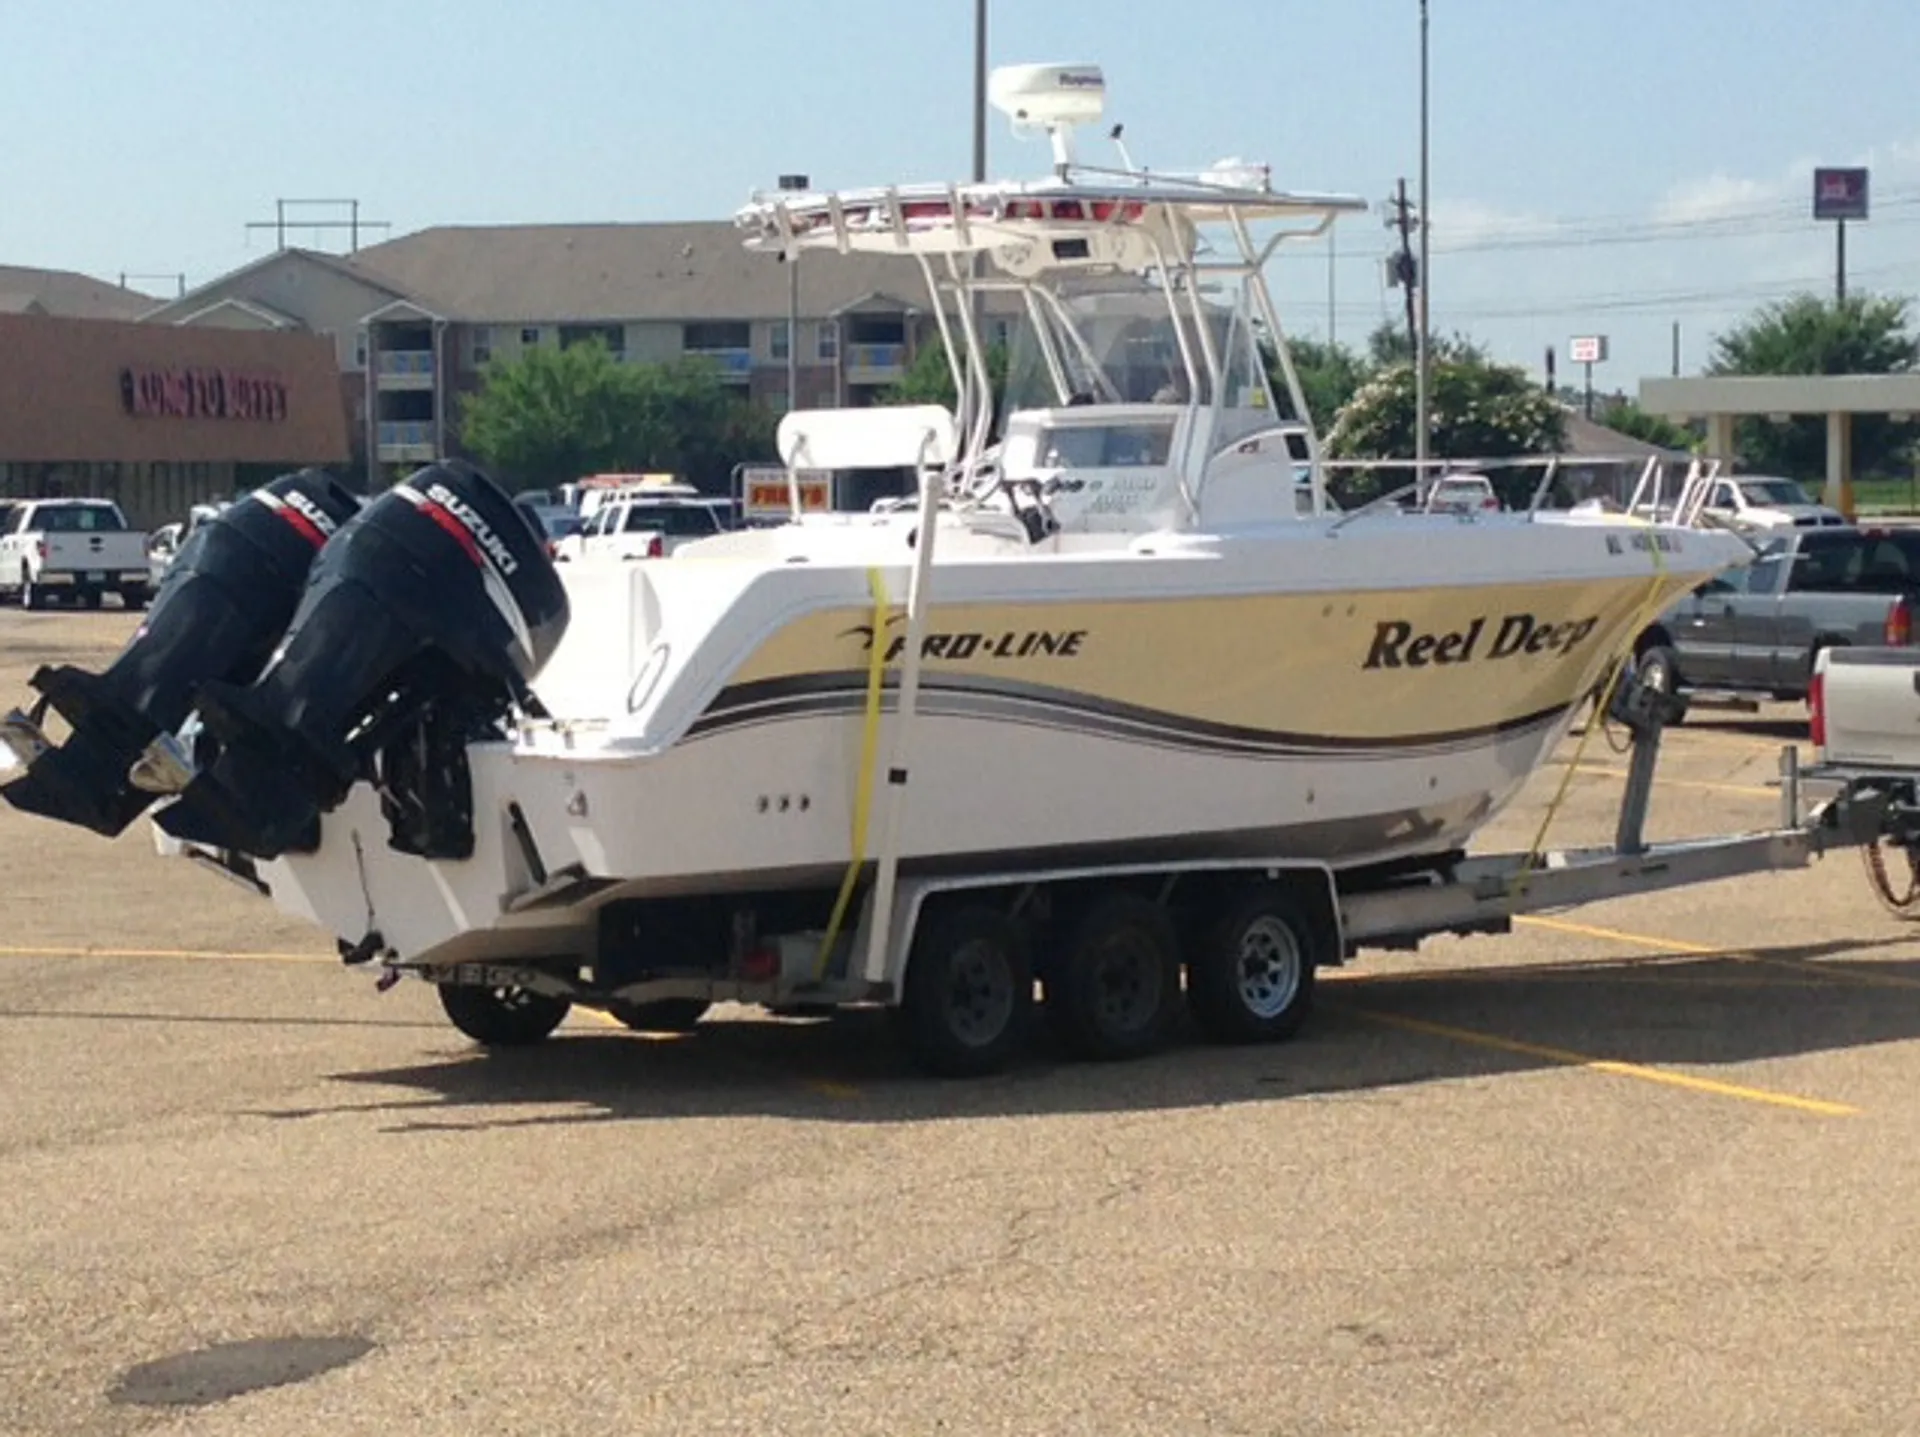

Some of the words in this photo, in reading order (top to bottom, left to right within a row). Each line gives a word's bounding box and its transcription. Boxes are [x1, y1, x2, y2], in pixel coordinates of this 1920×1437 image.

[425, 483, 519, 576] SUZUKI
[1362, 616, 1487, 671] Reel
[1486, 613, 1599, 661] Deep
